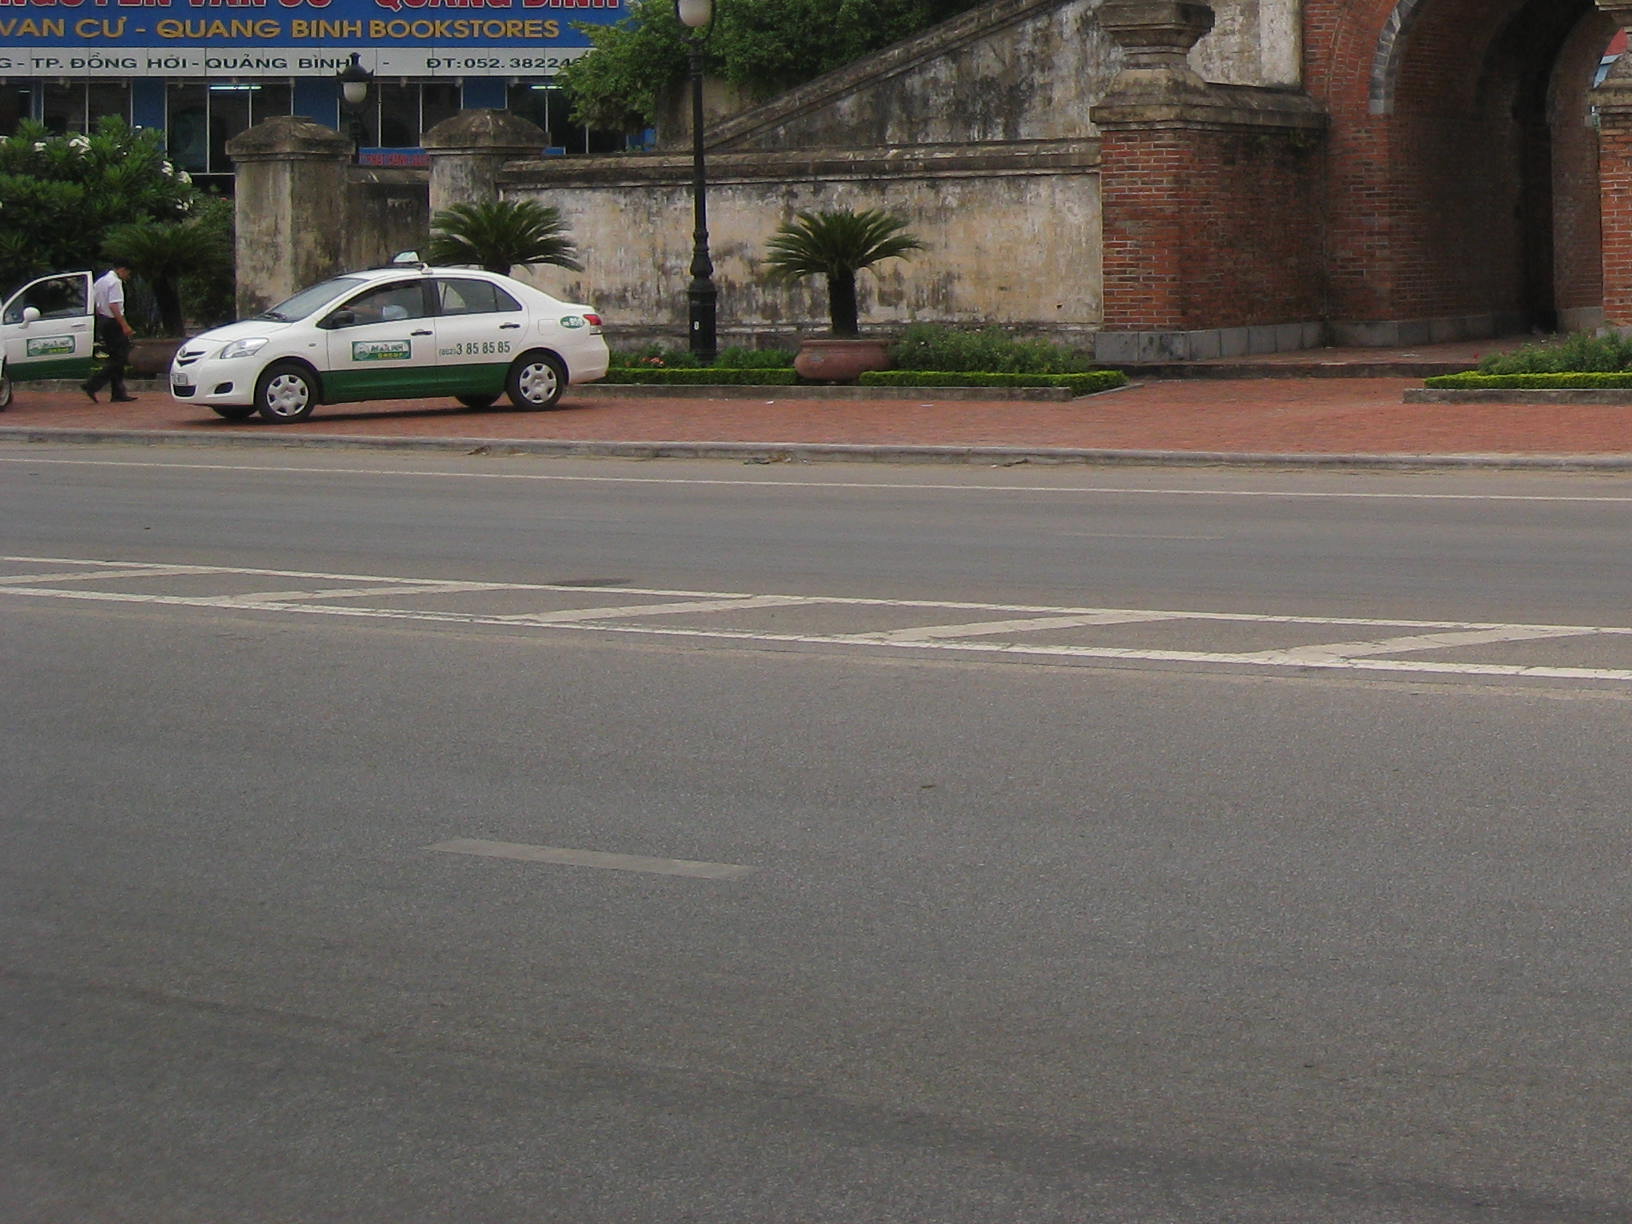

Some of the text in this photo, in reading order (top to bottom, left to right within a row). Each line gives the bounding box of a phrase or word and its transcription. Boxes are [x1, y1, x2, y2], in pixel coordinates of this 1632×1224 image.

[0, 18, 65, 38] VAN
[156, 19, 282, 39] QUANG
[292, 20, 362, 39] BINH
[369, 20, 560, 39] BOOKSTORES
[31, 58, 63, 69] TP.
[70, 52, 138, 69] ĐỒNG
[205, 53, 288, 69] QUẢNG
[298, 55, 350, 69] BÌNH
